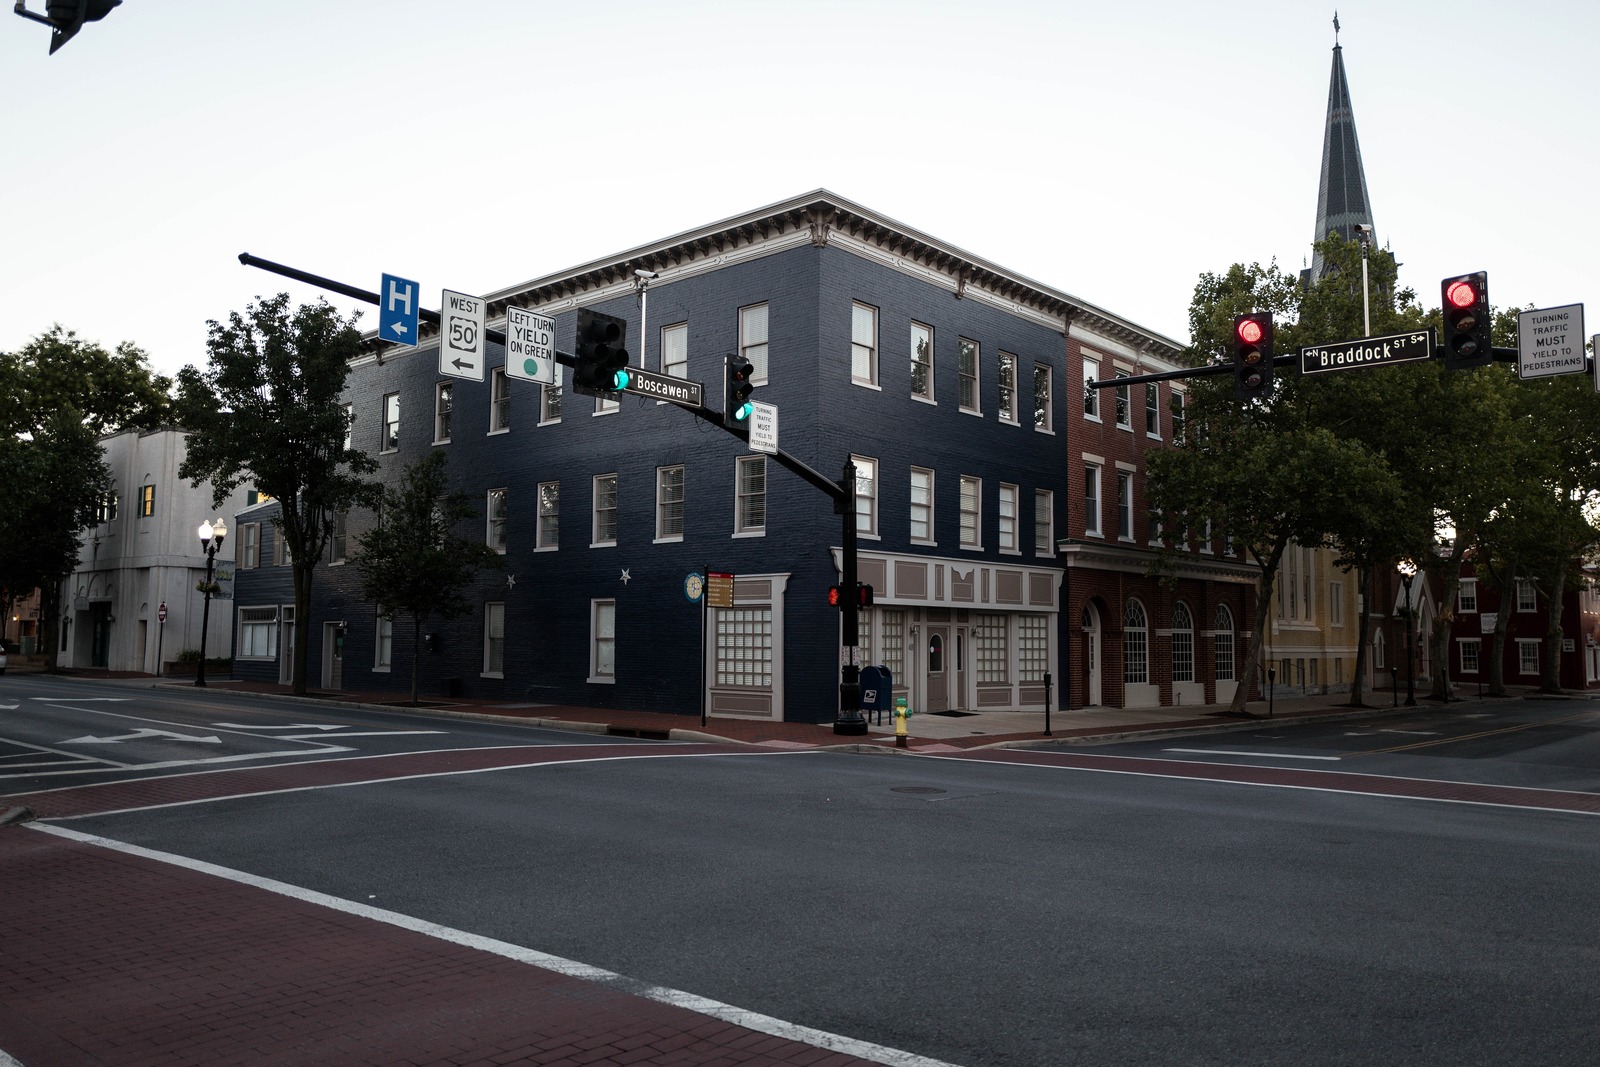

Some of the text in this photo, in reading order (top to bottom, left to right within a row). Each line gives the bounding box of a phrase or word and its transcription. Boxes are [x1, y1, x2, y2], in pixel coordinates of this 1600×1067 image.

[389, 280, 411, 315] H
[450, 296, 479, 314] WEST
[510, 311, 554, 332] LEFT TURN
[1532, 313, 1569, 324] TURNING
[453, 325, 474, 344] 50
[514, 326, 549, 345] YIELD
[1533, 324, 1568, 334] TRAFFIC
[1536, 335, 1566, 347] MUST
[510, 341, 552, 360] ON GREEN
[1312, 335, 1417, 366] N Braddock ST S
[1532, 347, 1571, 359] YIELD TO
[1523, 358, 1581, 371] PEDESTRIANS
[637, 375, 688, 399] Boscawen
[755, 407, 772, 415] TURNING
[757, 423, 770, 431] MUST
[751, 439, 775, 449] PEDESTRIANS
